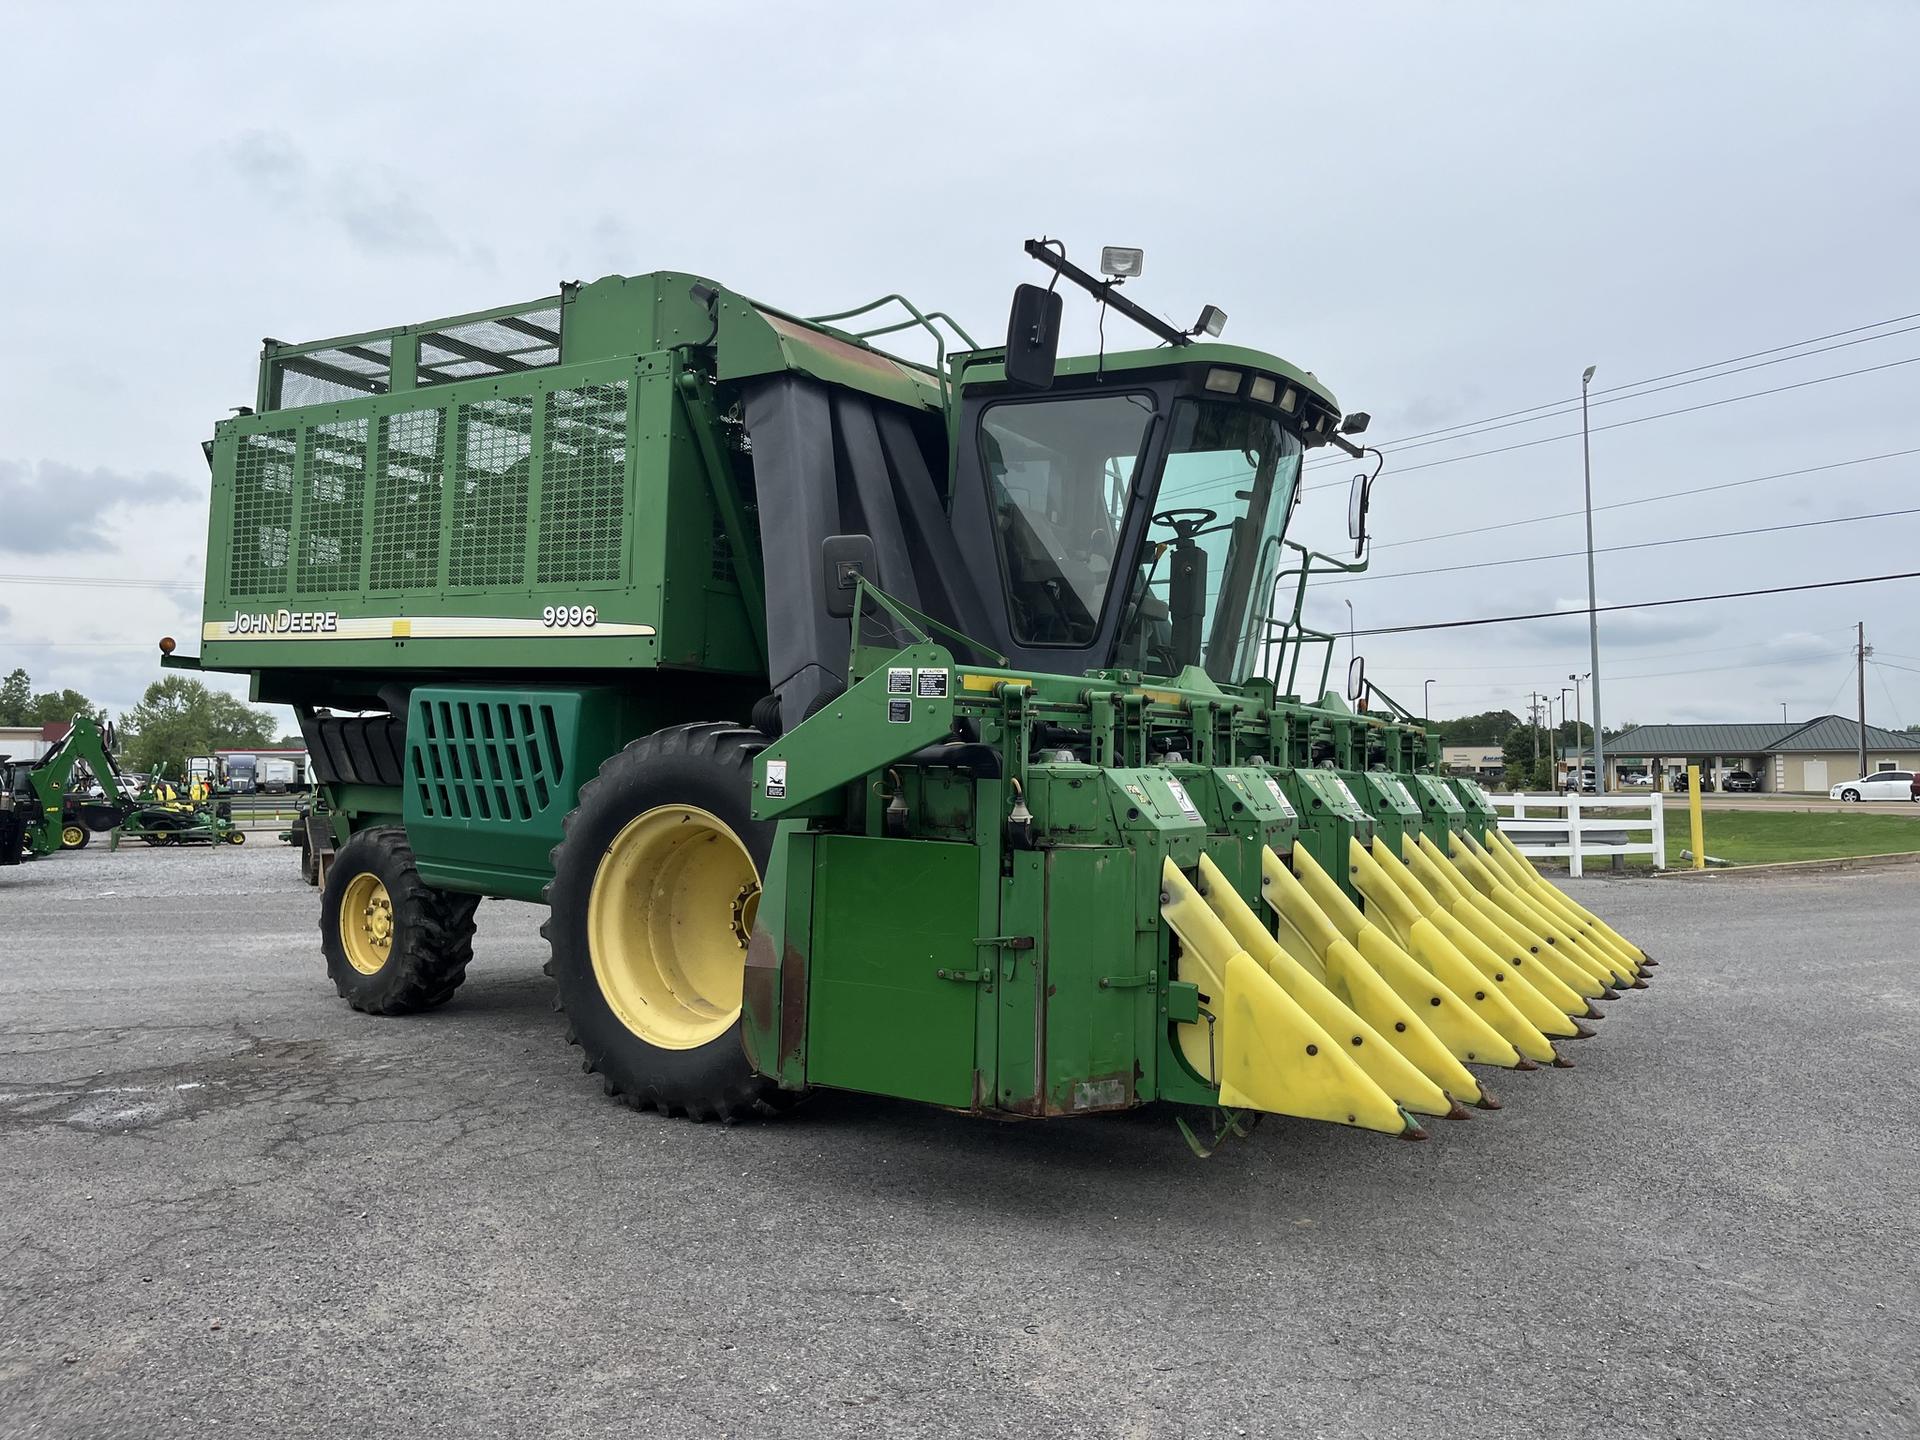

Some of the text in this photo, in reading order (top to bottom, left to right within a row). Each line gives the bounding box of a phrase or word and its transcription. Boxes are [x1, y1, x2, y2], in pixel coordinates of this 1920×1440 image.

[228, 609, 337, 633] JOHN DEERE
[543, 605, 597, 627] 9996
